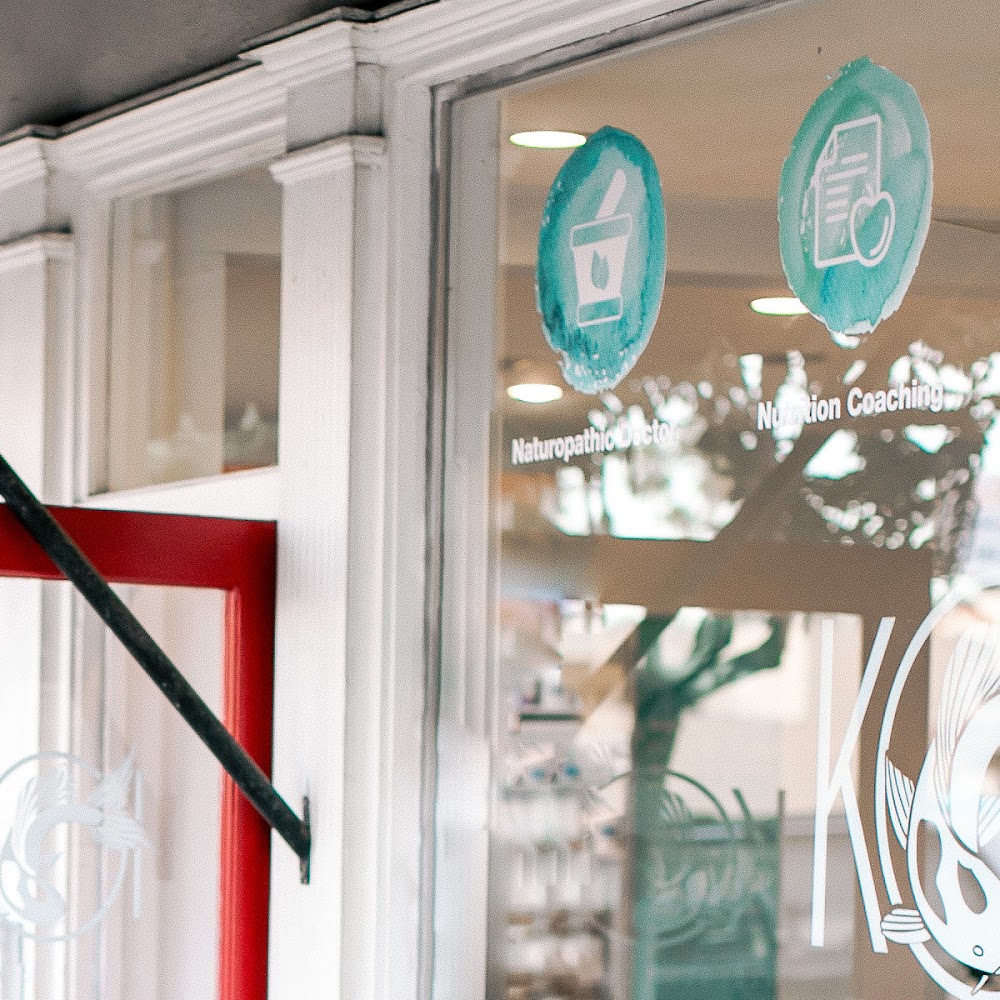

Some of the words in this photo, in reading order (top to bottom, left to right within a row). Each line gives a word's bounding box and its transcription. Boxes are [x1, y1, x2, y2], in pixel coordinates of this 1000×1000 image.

[756, 394, 841, 431] Nution
[846, 379, 943, 418] Coaching
[511, 425, 614, 466] Naturopathic
